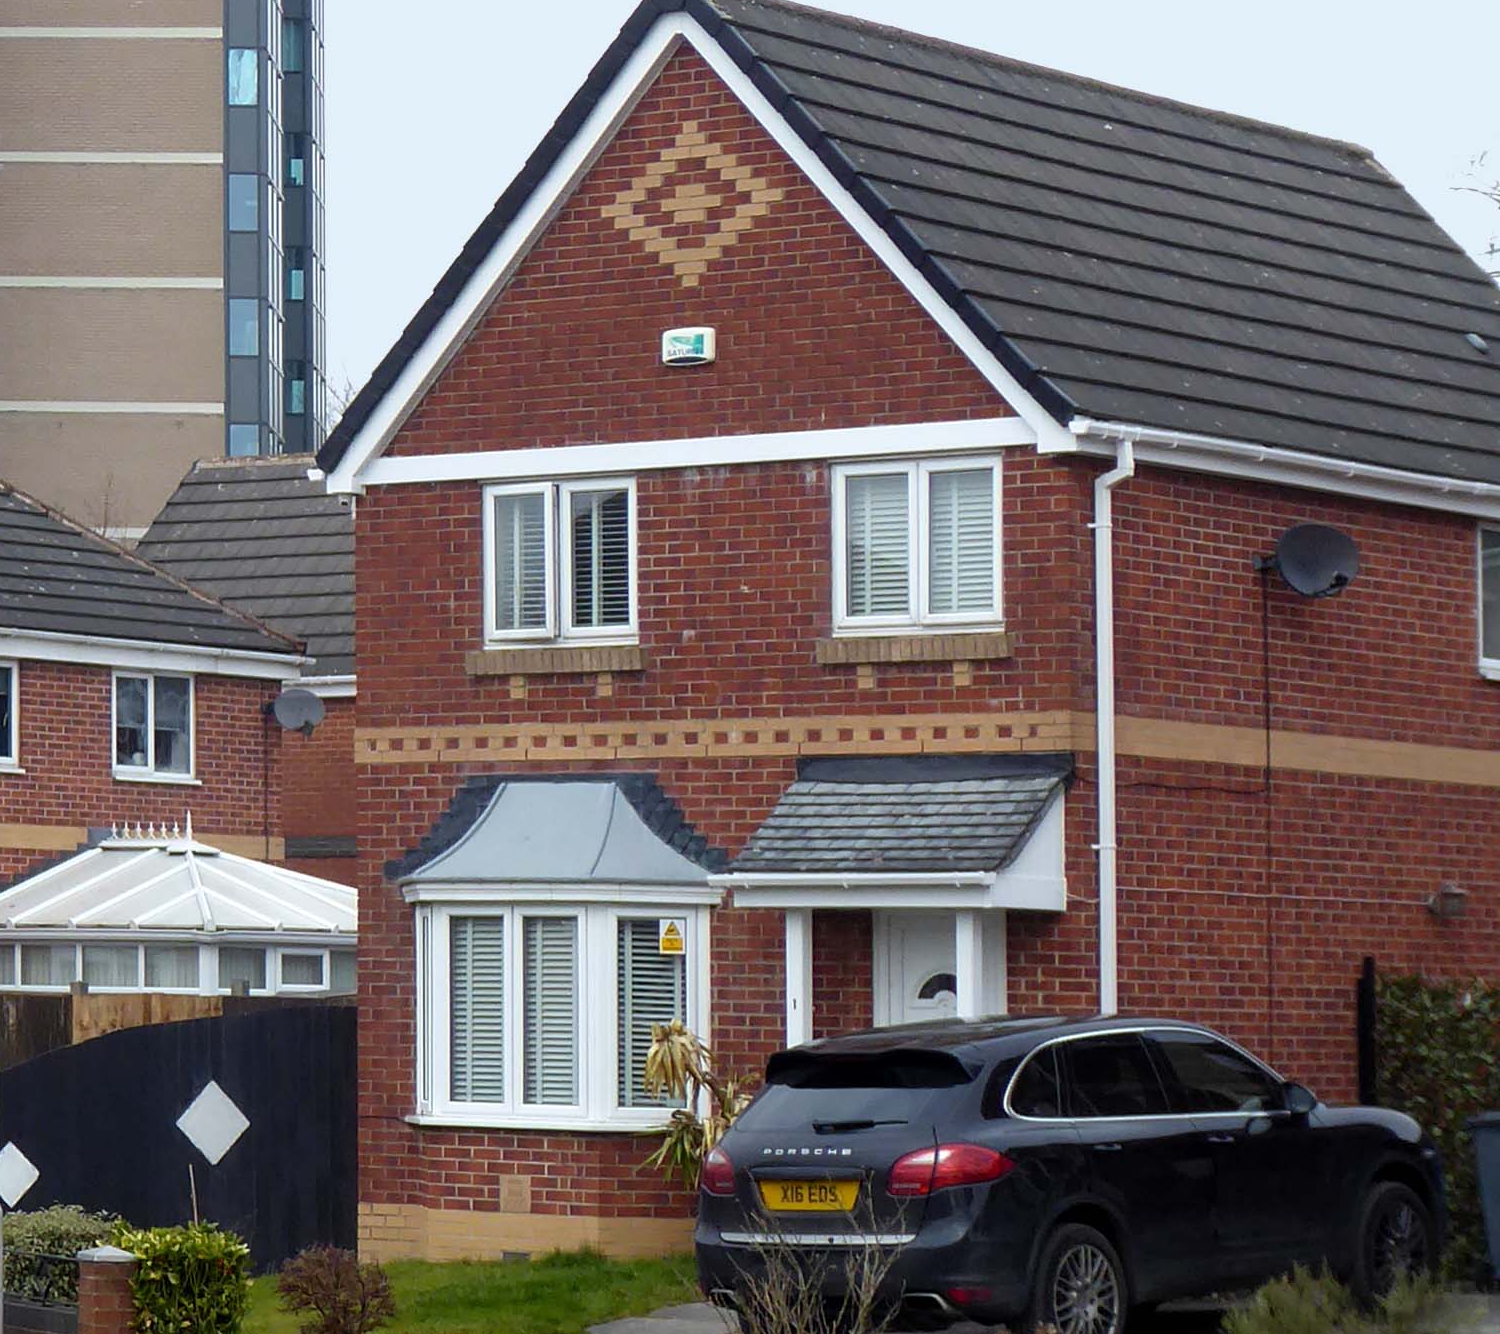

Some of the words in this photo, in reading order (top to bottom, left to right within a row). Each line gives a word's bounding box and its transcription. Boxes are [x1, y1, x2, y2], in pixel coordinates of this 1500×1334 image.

[763, 1148, 852, 1156] PORSCHE
[780, 1186, 804, 1203] X16
[808, 1186, 838, 1203] EDS
